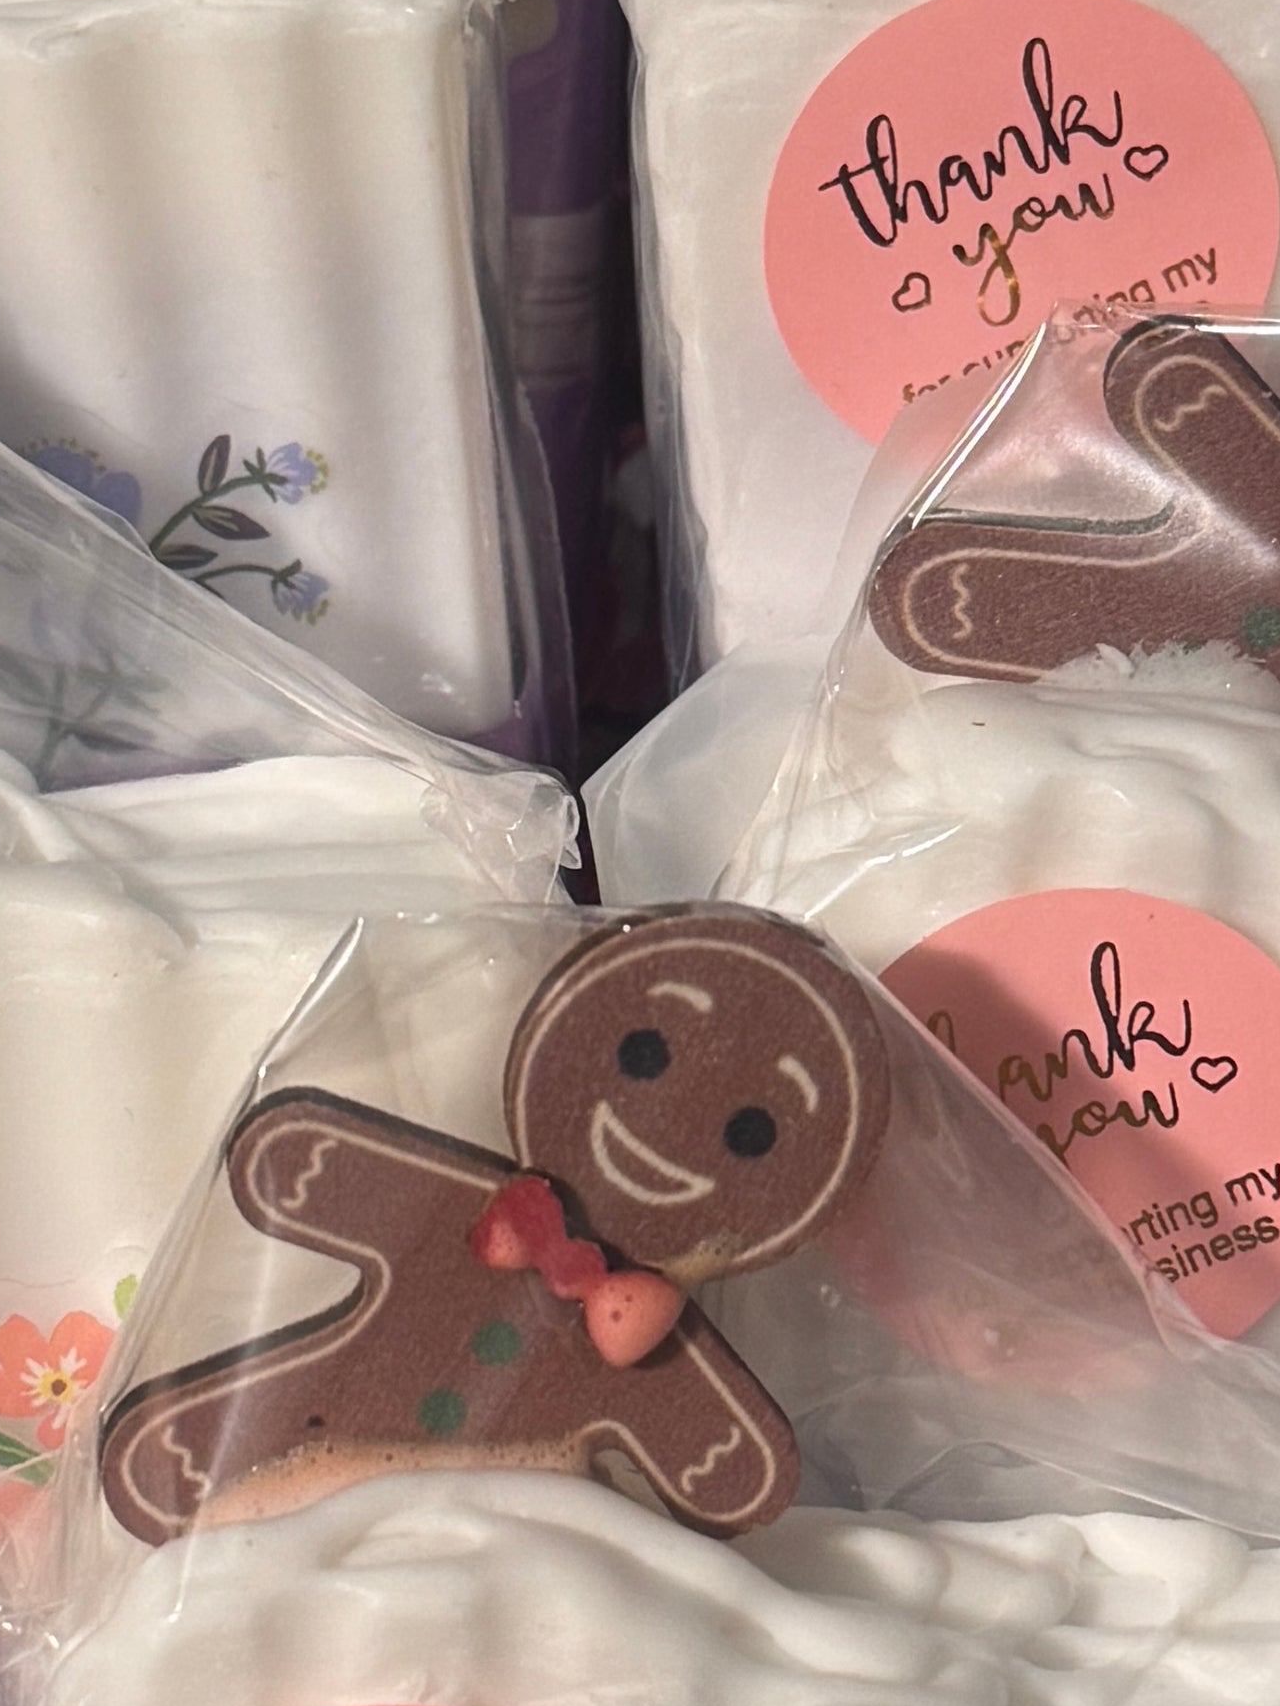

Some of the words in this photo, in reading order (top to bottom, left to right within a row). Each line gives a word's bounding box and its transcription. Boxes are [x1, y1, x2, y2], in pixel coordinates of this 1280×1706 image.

[818, 37, 1123, 248] thank
[951, 173, 1115, 326] you
[1161, 246, 1218, 294] my
[926, 941, 1192, 1103] ank
[1120, 1191, 1219, 1246] rting
[1154, 1214, 1280, 1283] siness
